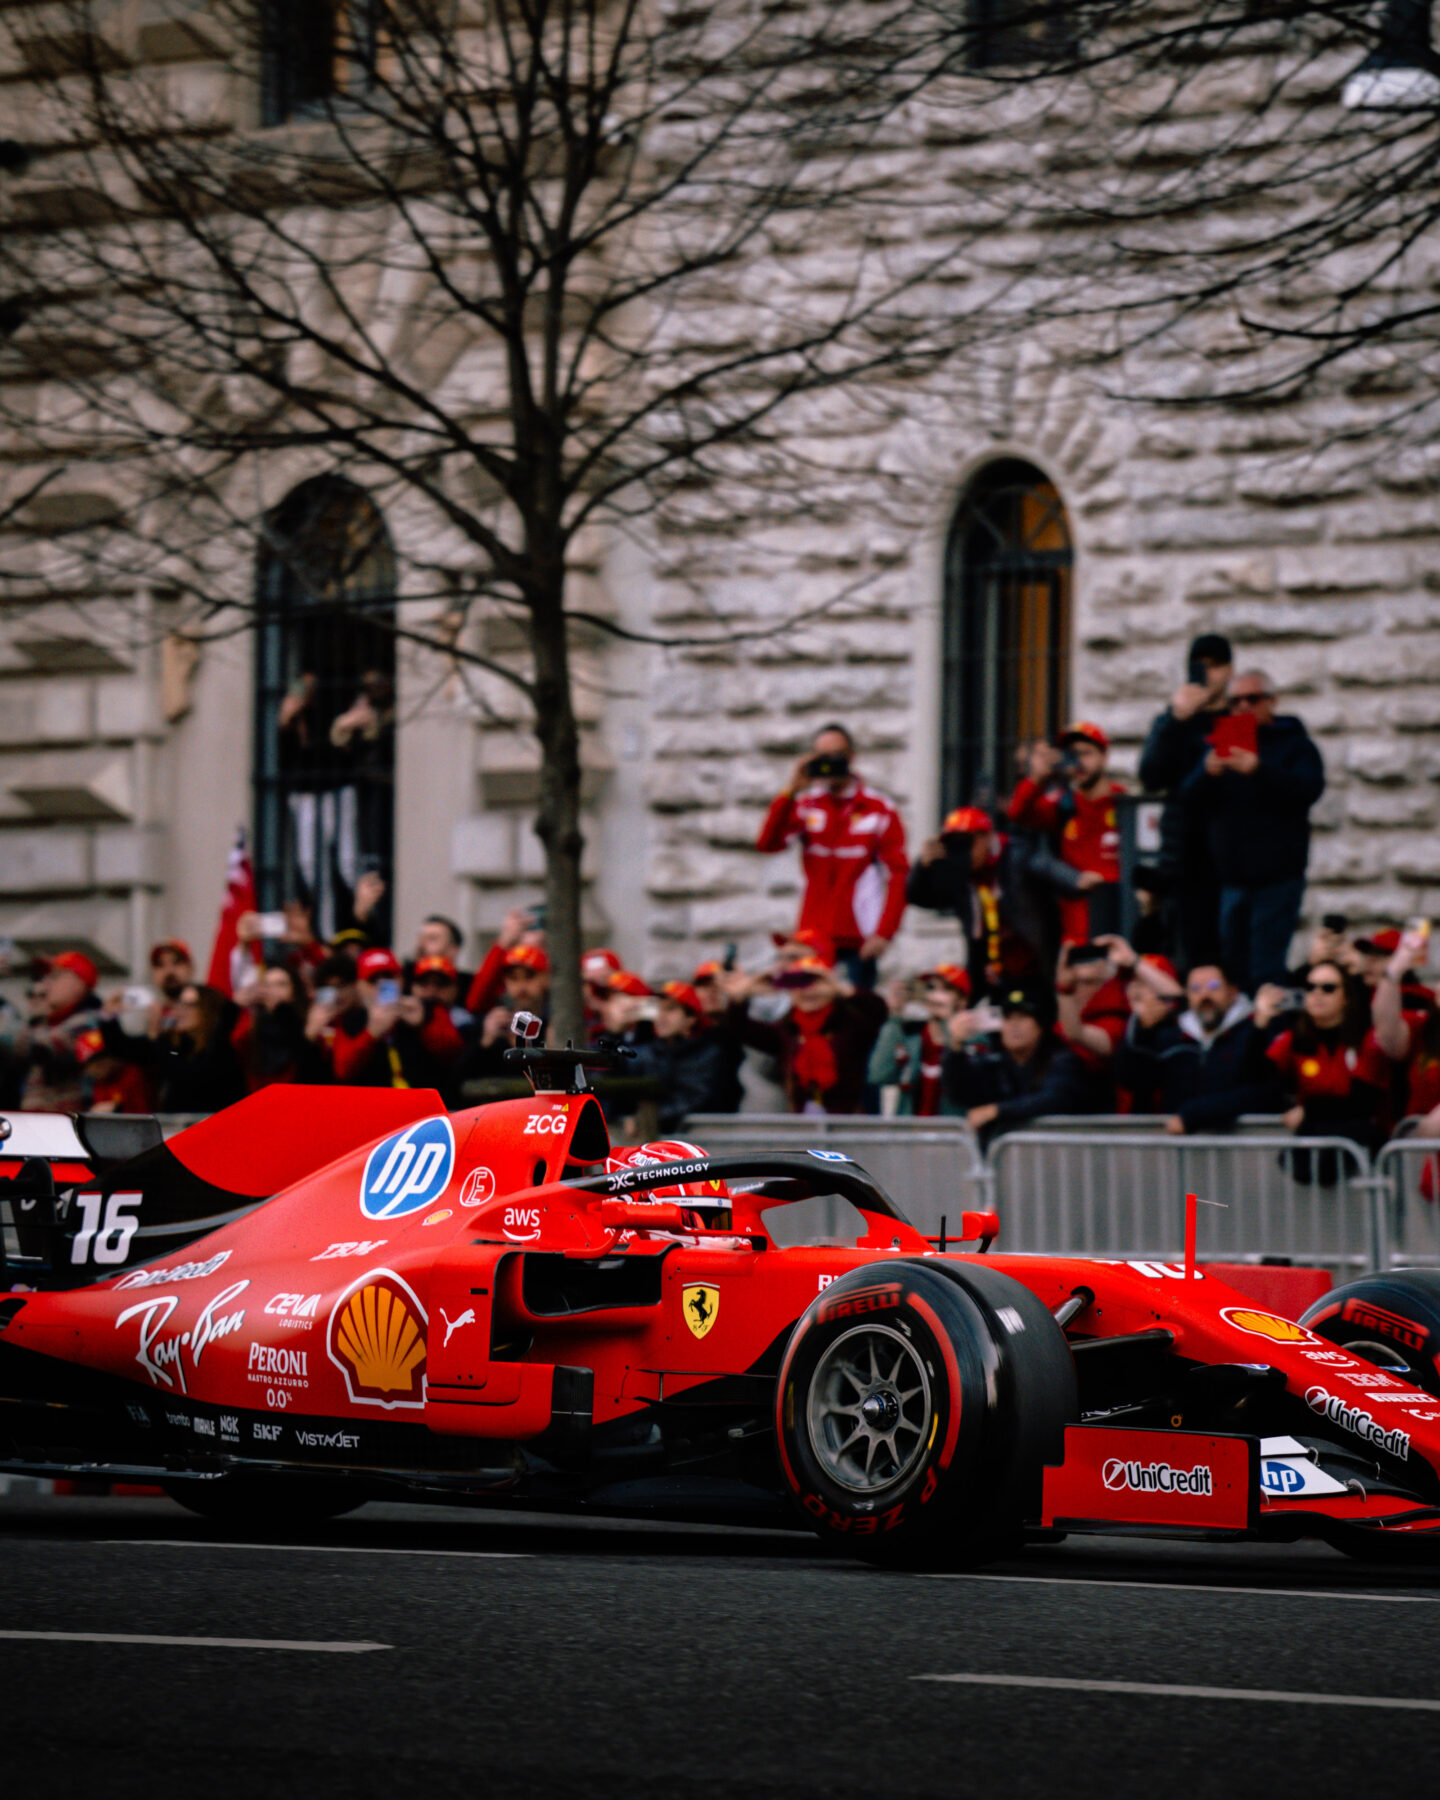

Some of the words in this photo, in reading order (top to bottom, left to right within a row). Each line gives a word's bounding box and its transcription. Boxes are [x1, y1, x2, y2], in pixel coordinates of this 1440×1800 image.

[523, 1114, 568, 1135] ZCG
[607, 1171, 635, 1191] DXC
[636, 1162, 710, 1182] TECHNOLOGY
[70, 1189, 144, 1265] 16
[503, 1207, 541, 1228] aws
[816, 1282, 904, 1325] PIRELLI
[278, 1319, 313, 1331] LOGISTICS
[1341, 1297, 1431, 1352] PIRELLI
[247, 1341, 308, 1377] PERONI
[273, 1376, 309, 1389] AZZURRO
[266, 1387, 293, 1409] 0.0%
[219, 1414, 240, 1434] NGK
[252, 1422, 283, 1441] SKF
[1326, 1395, 1411, 1460] UniCredit
[1125, 1459, 1213, 1496] UniCredit
[1260, 1461, 1298, 1493] hp
[802, 1491, 906, 1538] ZERO
